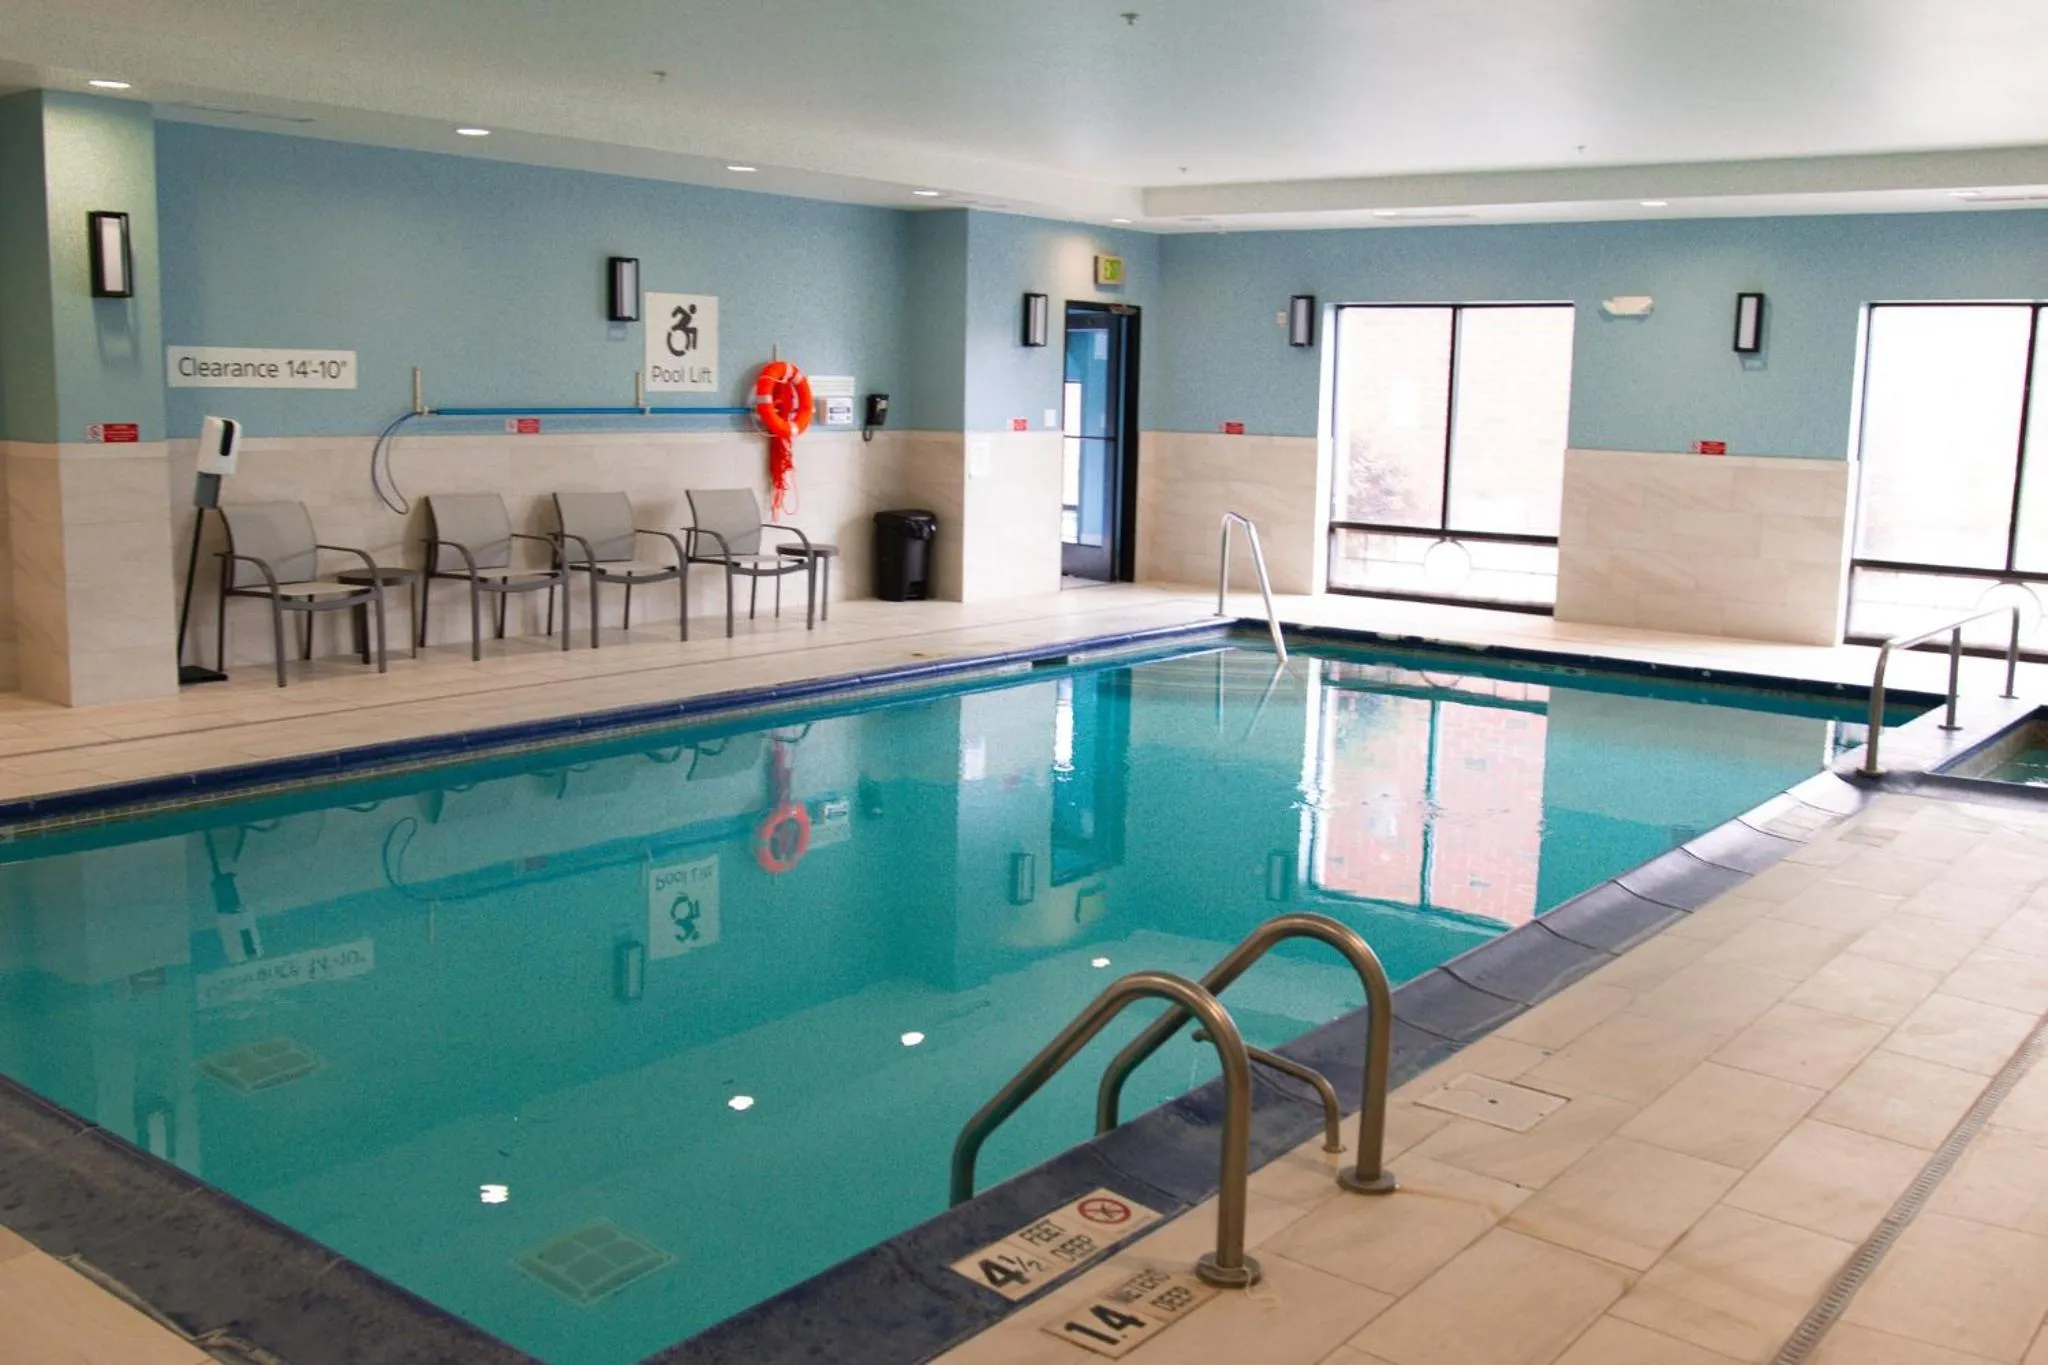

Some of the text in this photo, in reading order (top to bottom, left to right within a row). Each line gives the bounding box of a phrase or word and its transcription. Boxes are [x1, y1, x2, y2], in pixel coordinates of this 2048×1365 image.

[177, 355, 279, 378] Clearance
[651, 364, 713, 384] Pool Lift
[1018, 1219, 1066, 1246] FEET
[1049, 1234, 1100, 1263] DEEP
[1150, 1286, 1192, 1312] DEEP
[1064, 1304, 1147, 1346] 1.4
